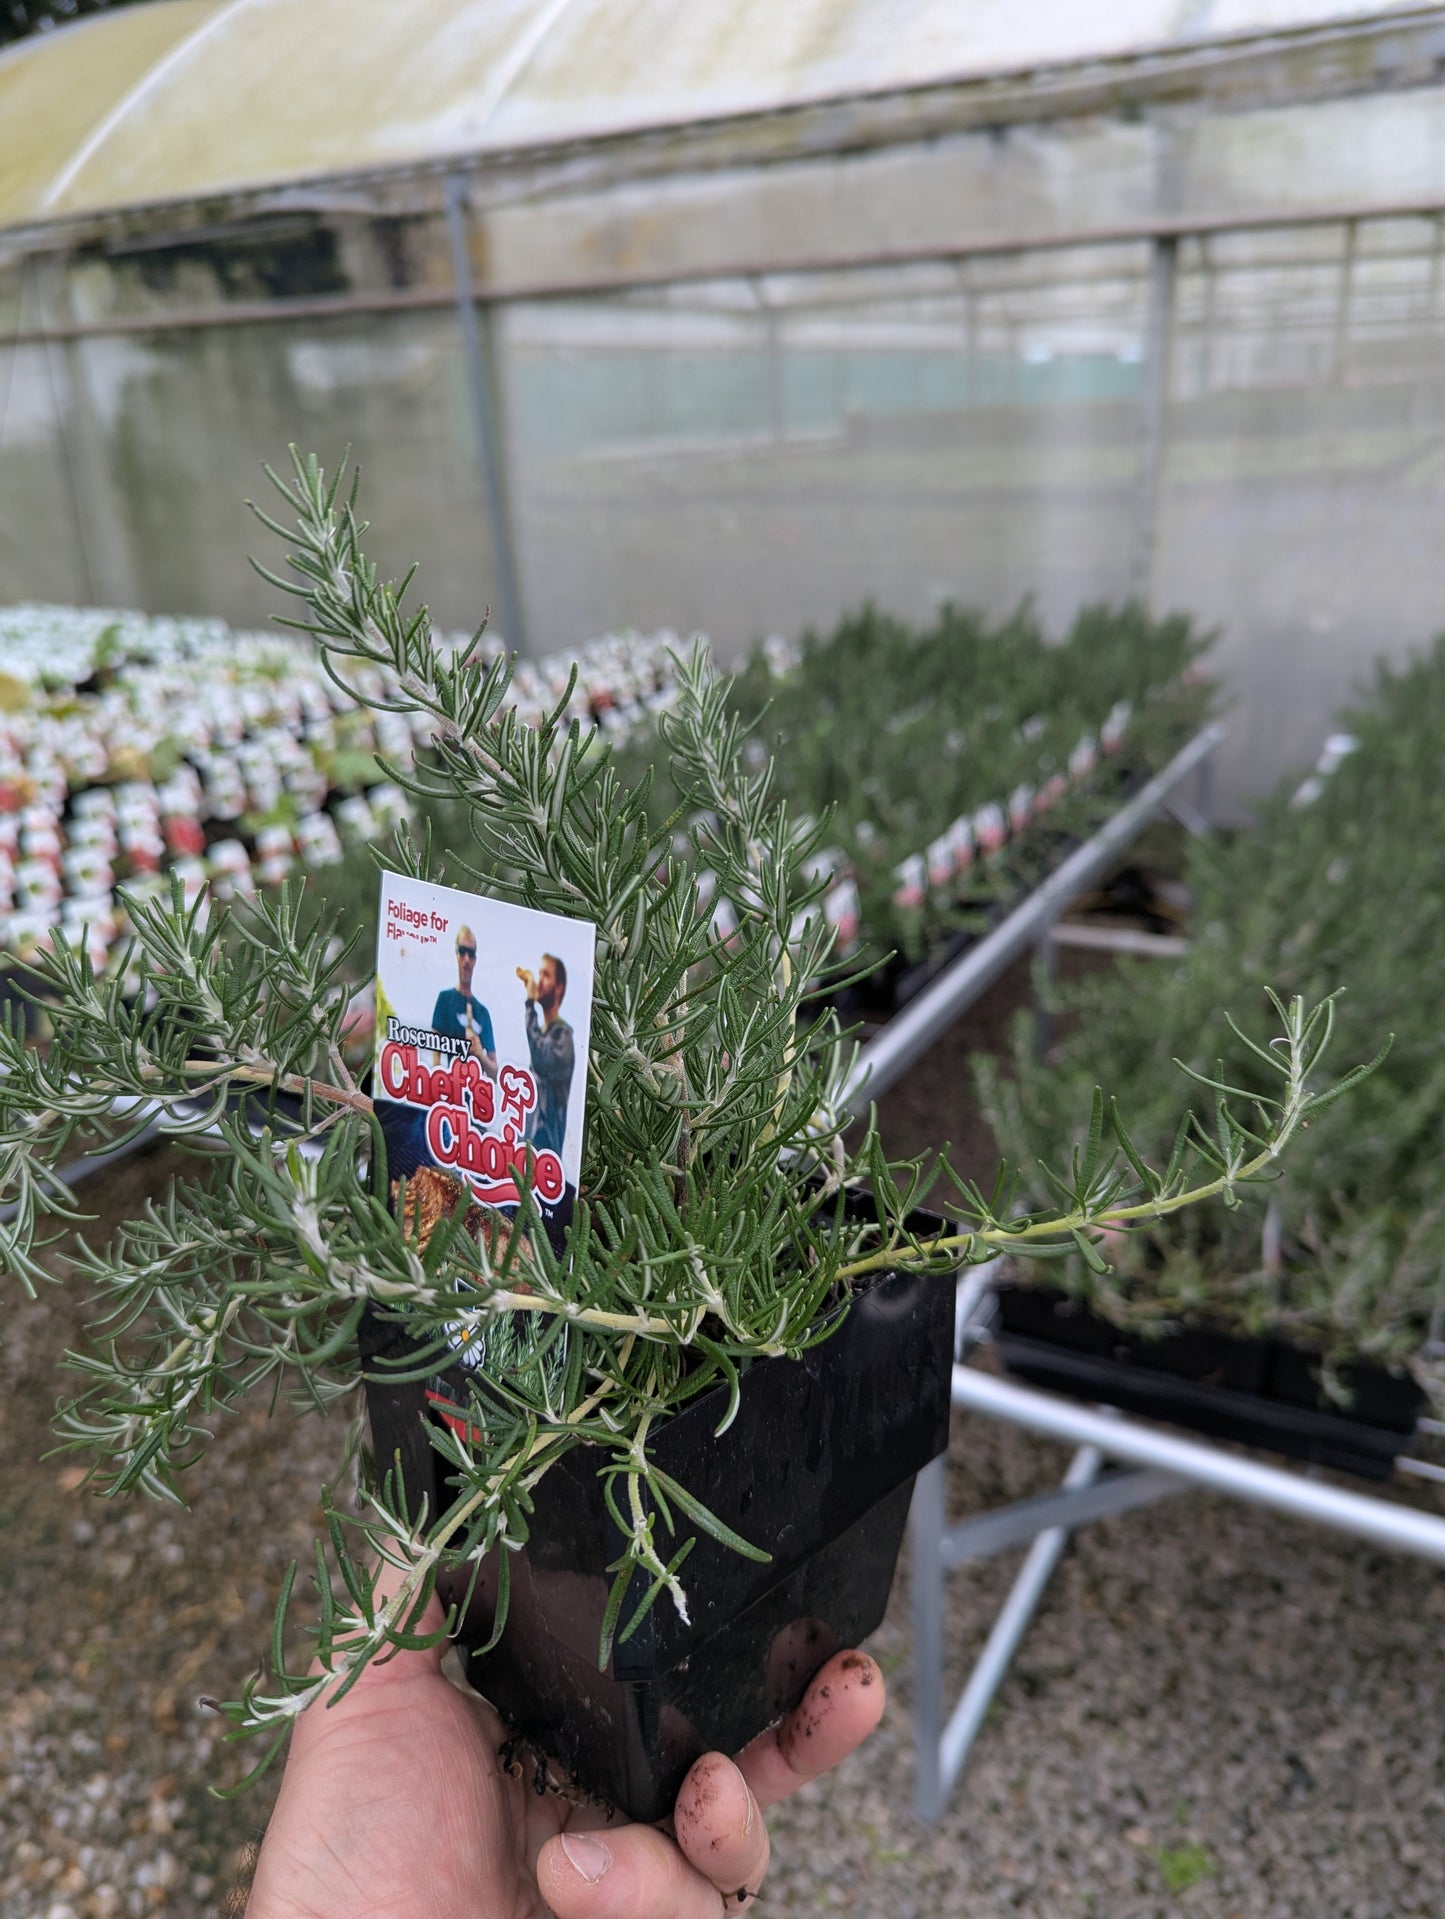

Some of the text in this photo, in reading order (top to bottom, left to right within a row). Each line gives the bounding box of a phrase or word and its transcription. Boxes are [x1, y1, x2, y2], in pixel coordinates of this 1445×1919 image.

[387, 899, 449, 932] Foliage for
[387, 1017, 472, 1062] Rosemary
[381, 1042, 495, 1123] Chef's
